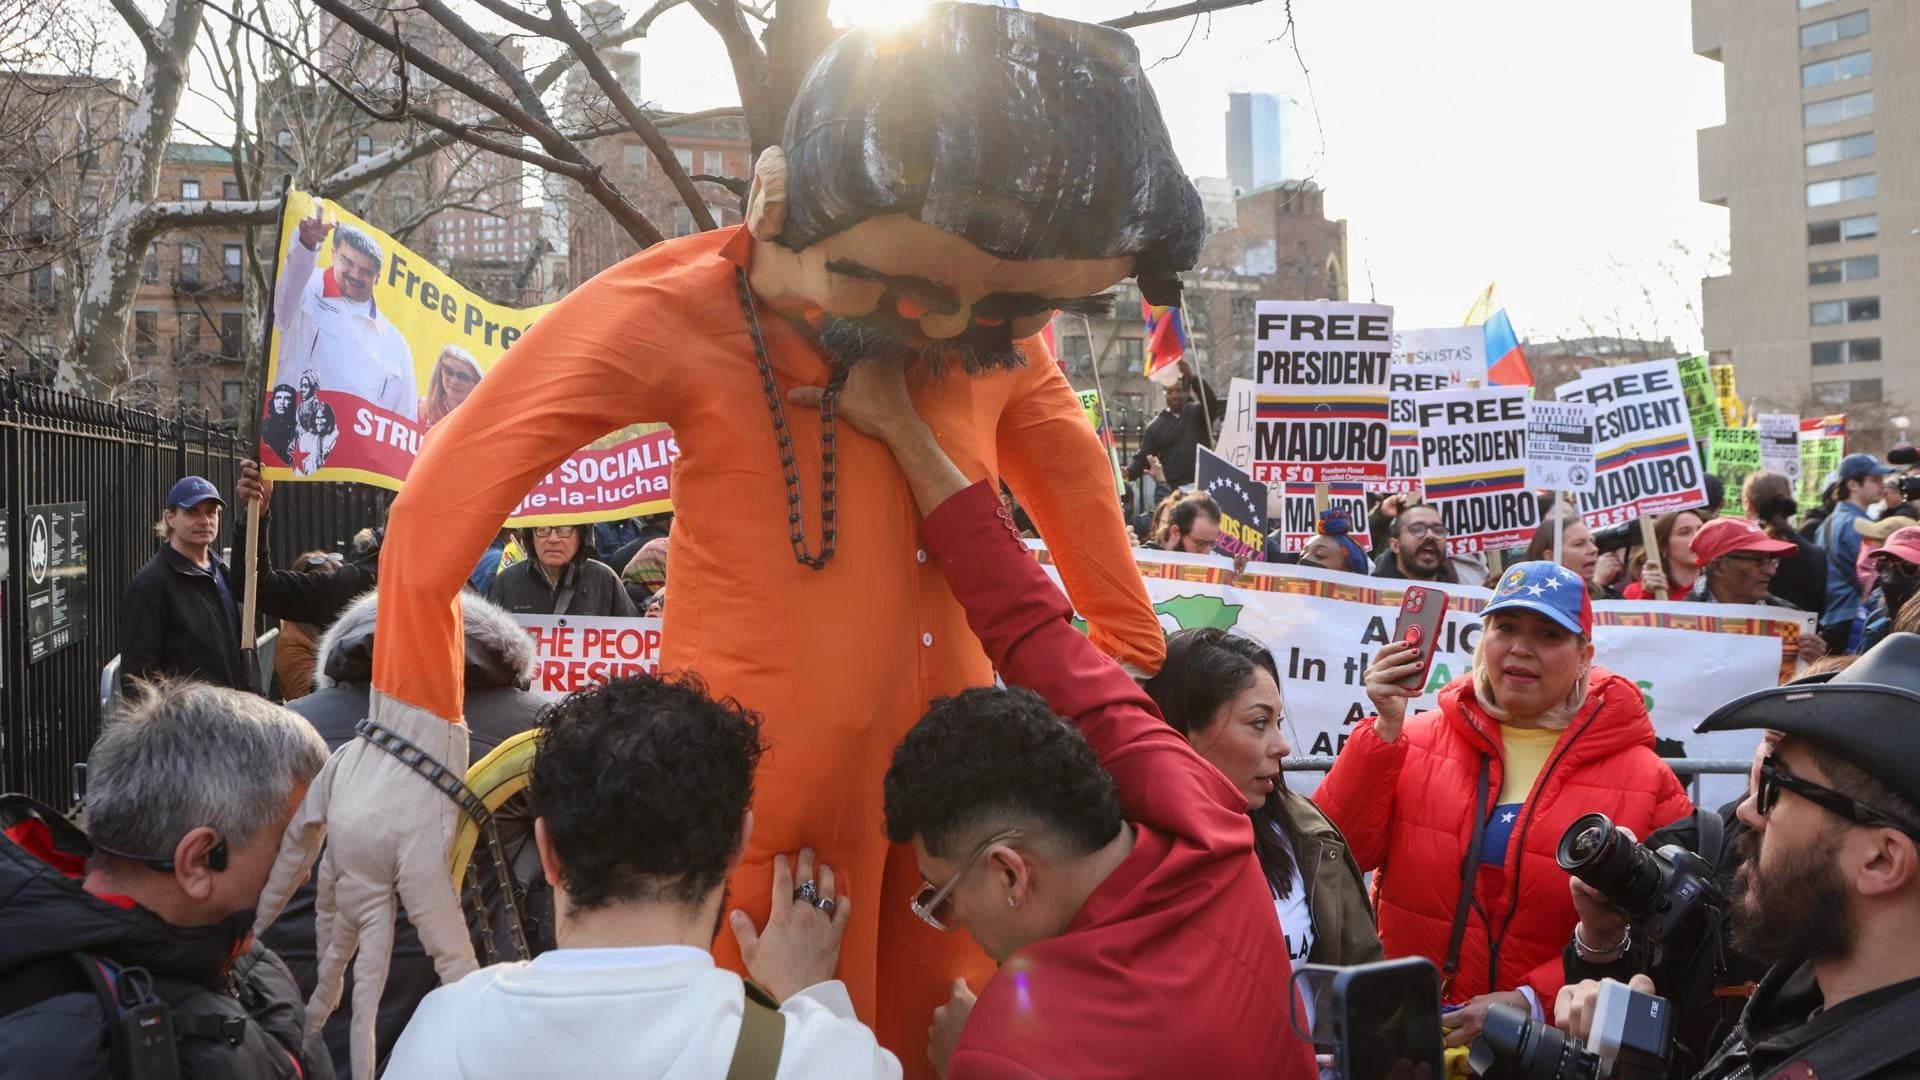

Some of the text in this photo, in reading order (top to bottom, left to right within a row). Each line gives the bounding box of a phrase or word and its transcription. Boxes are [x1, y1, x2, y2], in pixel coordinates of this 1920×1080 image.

[388, 252, 533, 351] Free Pre
[1258, 314, 1389, 341] FREE
[1256, 350, 1391, 384] PRESIDENT
[1389, 373, 1449, 392] REE
[1418, 397, 1526, 427] FREE
[1595, 397, 1682, 443] ESIDENT
[353, 407, 681, 484] STRU SOCIALIS
[1255, 421, 1388, 462] MADURO
[1421, 429, 1526, 467] PRESIDENT
[1255, 465, 1314, 482] FRSO
[1581, 455, 1698, 512] MADURO
[1285, 497, 1366, 533] MARO
[1427, 491, 1536, 537] MADURO
[1242, 525, 1264, 552] OFF
[582, 629, 661, 660] PEOP
[1289, 647, 1326, 682] In
